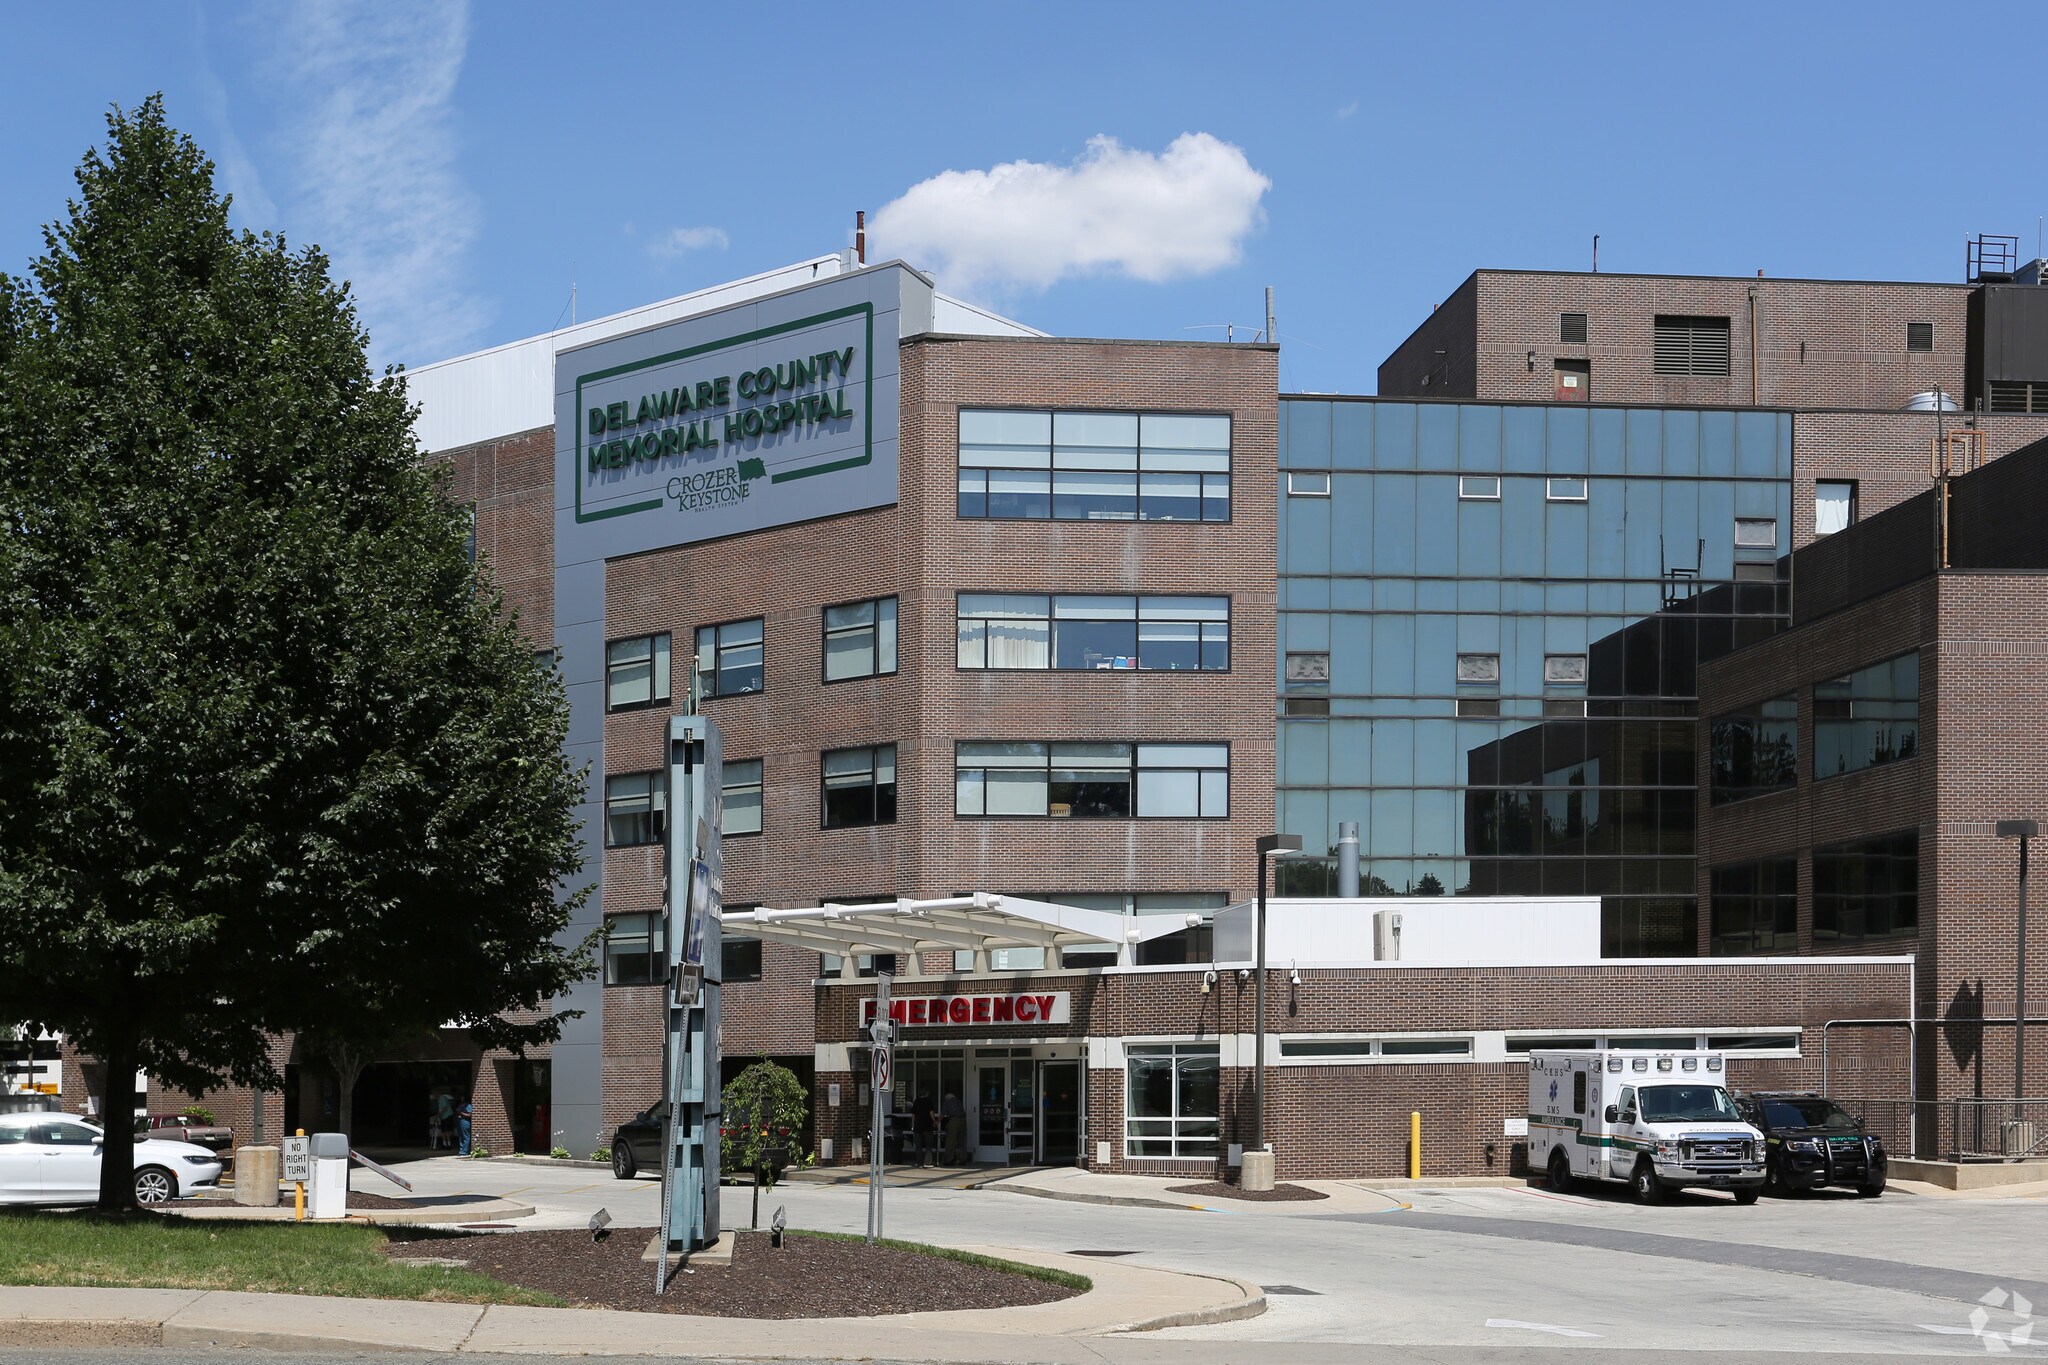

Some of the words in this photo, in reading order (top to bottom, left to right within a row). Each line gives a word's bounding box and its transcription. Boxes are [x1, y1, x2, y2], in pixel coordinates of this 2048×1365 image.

[589, 376, 730, 434] DELAWARE
[737, 346, 854, 399] COUNTY
[588, 420, 719, 473] MEMORIAL
[724, 389, 853, 443] HOSPITAL
[678, 483, 750, 512] KEYSTONE
[864, 995, 1056, 1025] EMERGENCY
[1543, 1068, 1564, 1077] CKHS
[1547, 1105, 1560, 1114] EMS
[292, 1143, 301, 1151] NO
[286, 1154, 306, 1163] RIGHT
[288, 1166, 306, 1174] TURN
